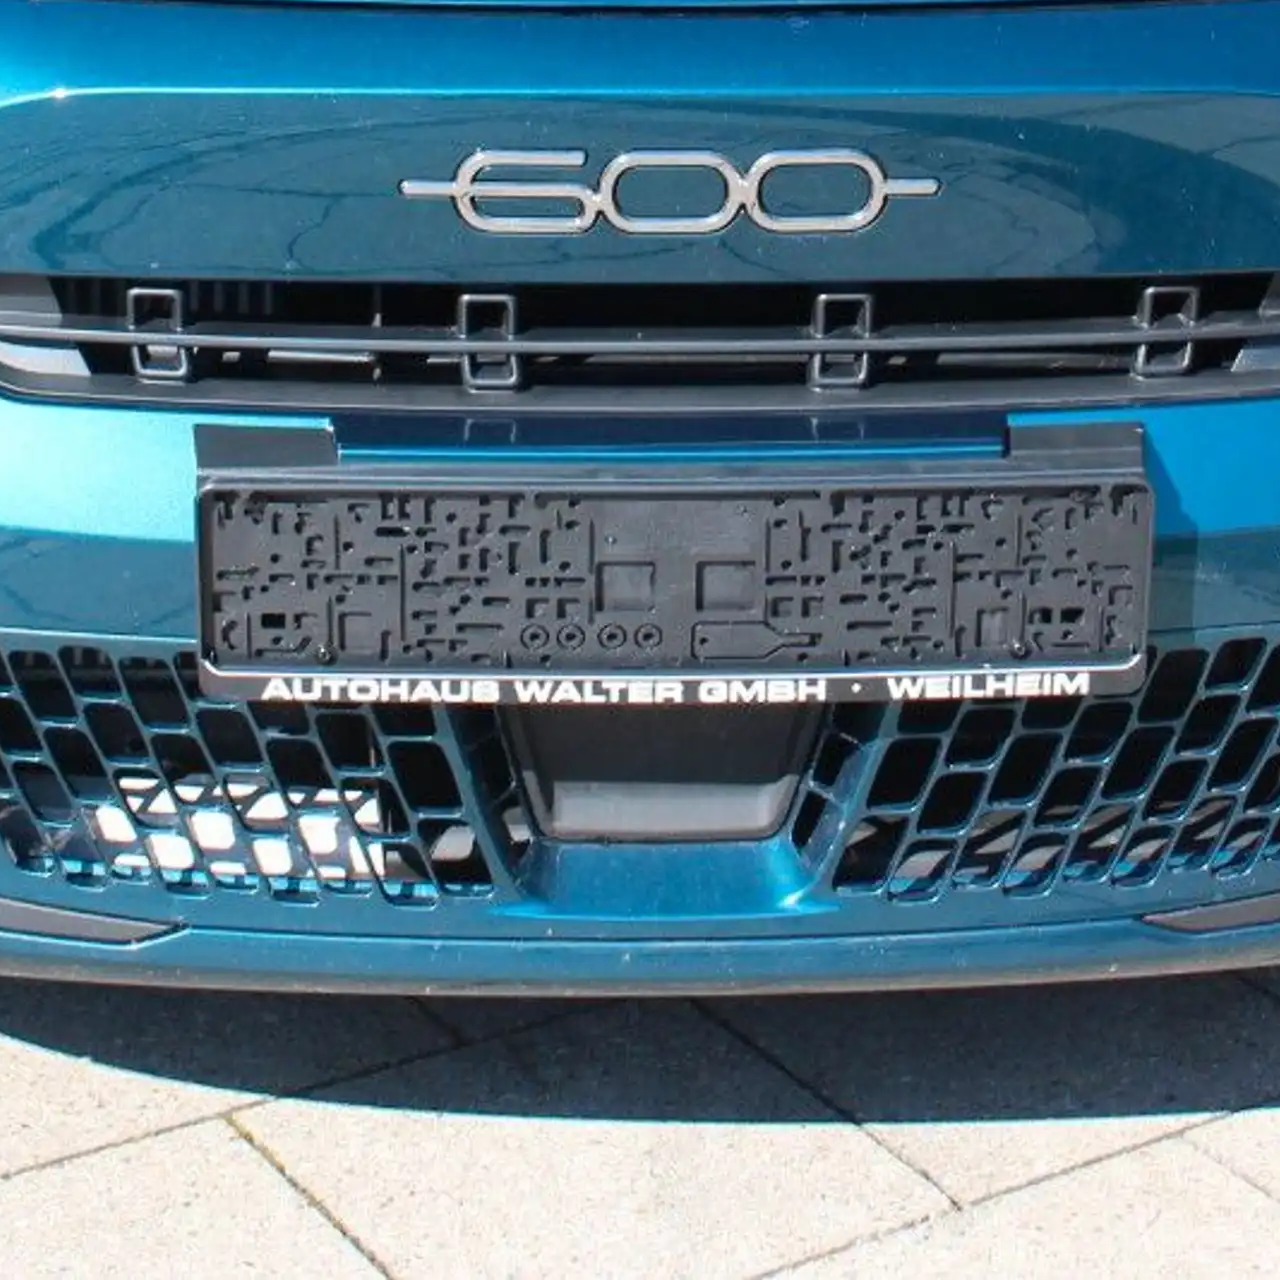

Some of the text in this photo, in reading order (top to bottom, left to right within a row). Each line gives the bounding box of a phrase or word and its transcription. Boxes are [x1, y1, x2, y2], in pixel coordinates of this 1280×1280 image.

[398, 148, 940, 233] 600
[261, 678, 500, 702] AUTOHAUS
[514, 681, 685, 704] WALTER
[698, 680, 826, 704] GMBH
[886, 673, 1090, 699] WEILHEIM
